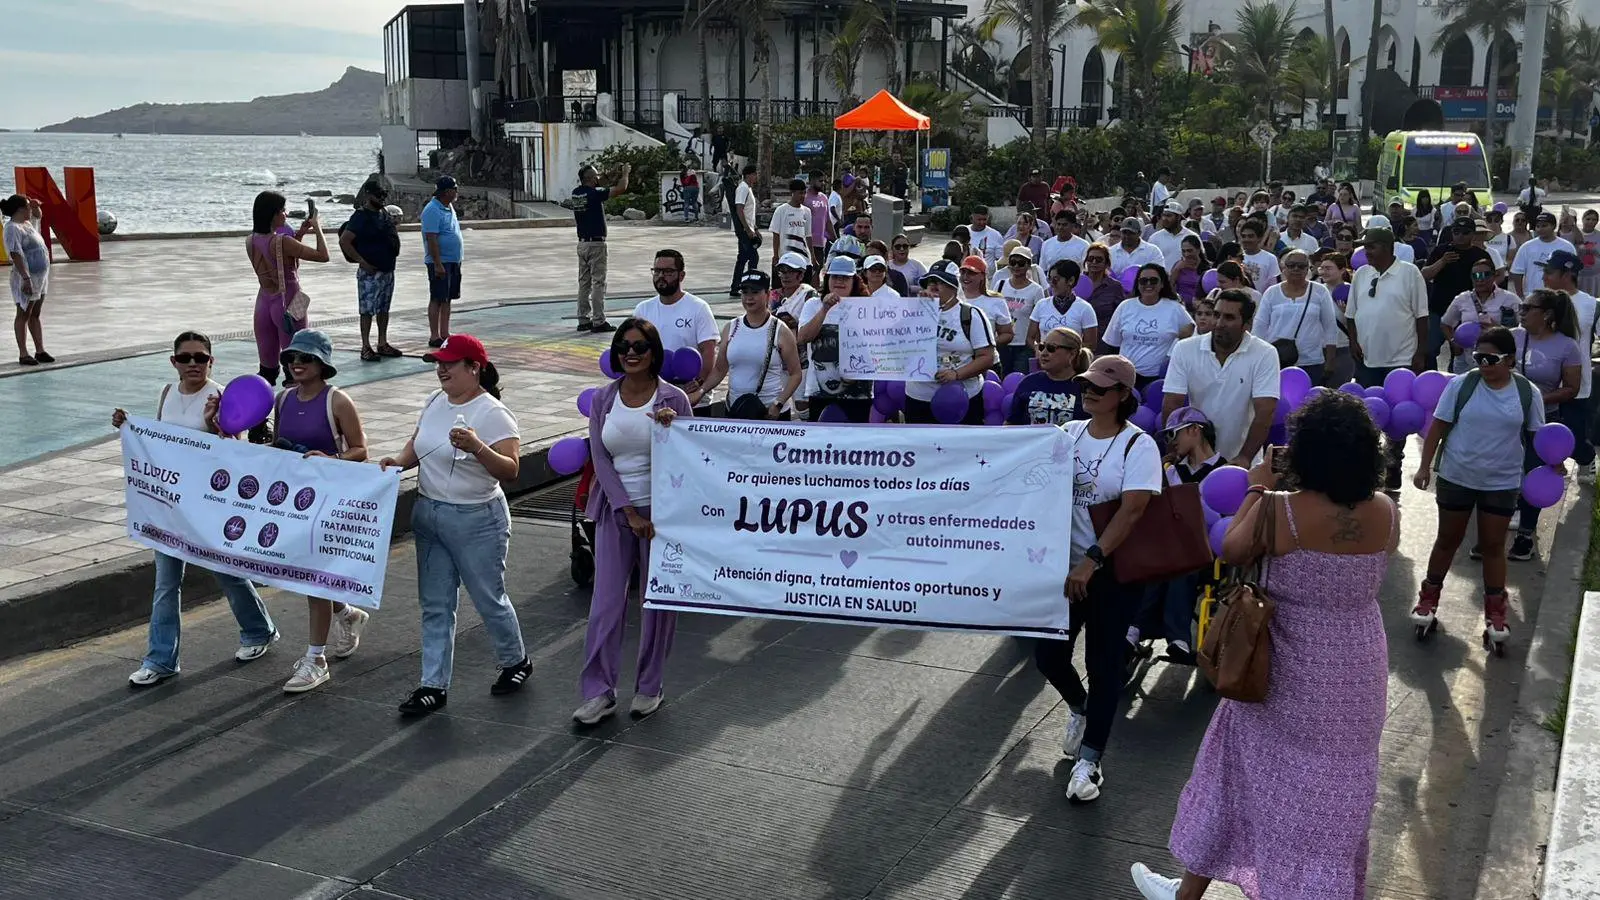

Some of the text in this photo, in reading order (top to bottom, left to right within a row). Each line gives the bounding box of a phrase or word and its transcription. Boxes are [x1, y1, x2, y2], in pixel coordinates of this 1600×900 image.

[929, 150, 946, 169] 1000
[0, 166, 100, 264] N
[675, 318, 692, 328] CK
[687, 424, 806, 437] #LEYLUPUSYAUTOINMUNES
[772, 441, 916, 467] Caminamos
[130, 459, 180, 485] EL LUPUS
[727, 471, 970, 491] Por quienes luchamos todos los días
[127, 476, 181, 504] PUEDE AFETAR
[232, 500, 256, 511] CEREBRO
[259, 506, 286, 517] PULMONES
[338, 498, 378, 511] EL ACCESO
[1073, 497, 1090, 509] Lup
[331, 509, 378, 524] DESIGUAL A
[701, 496, 1036, 539] Con LUPUS y otras enfermedades
[320, 520, 381, 538] TRATAMIENTOS
[223, 541, 233, 549] PIEL
[323, 533, 375, 550] ES VIOLENCIA
[906, 534, 1005, 551] autoinmunes.
[133, 522, 140, 531] EL
[141, 524, 180, 546] DIAGNSTICO
[233, 559, 280, 575] OPORTUNO
[281, 567, 317, 582] PUEDEN
[318, 575, 347, 590] SALVAR
[348, 581, 373, 595] VIDAS
[243, 545, 286, 559] ARTICULACIONES
[319, 546, 376, 563] INSTITUCIONAL
[661, 561, 683, 569] Renacer
[713, 566, 1002, 601] ¡Atención digna, tratamientos oportunos y
[784, 591, 917, 614] JUSTICIA EN SALUD!
